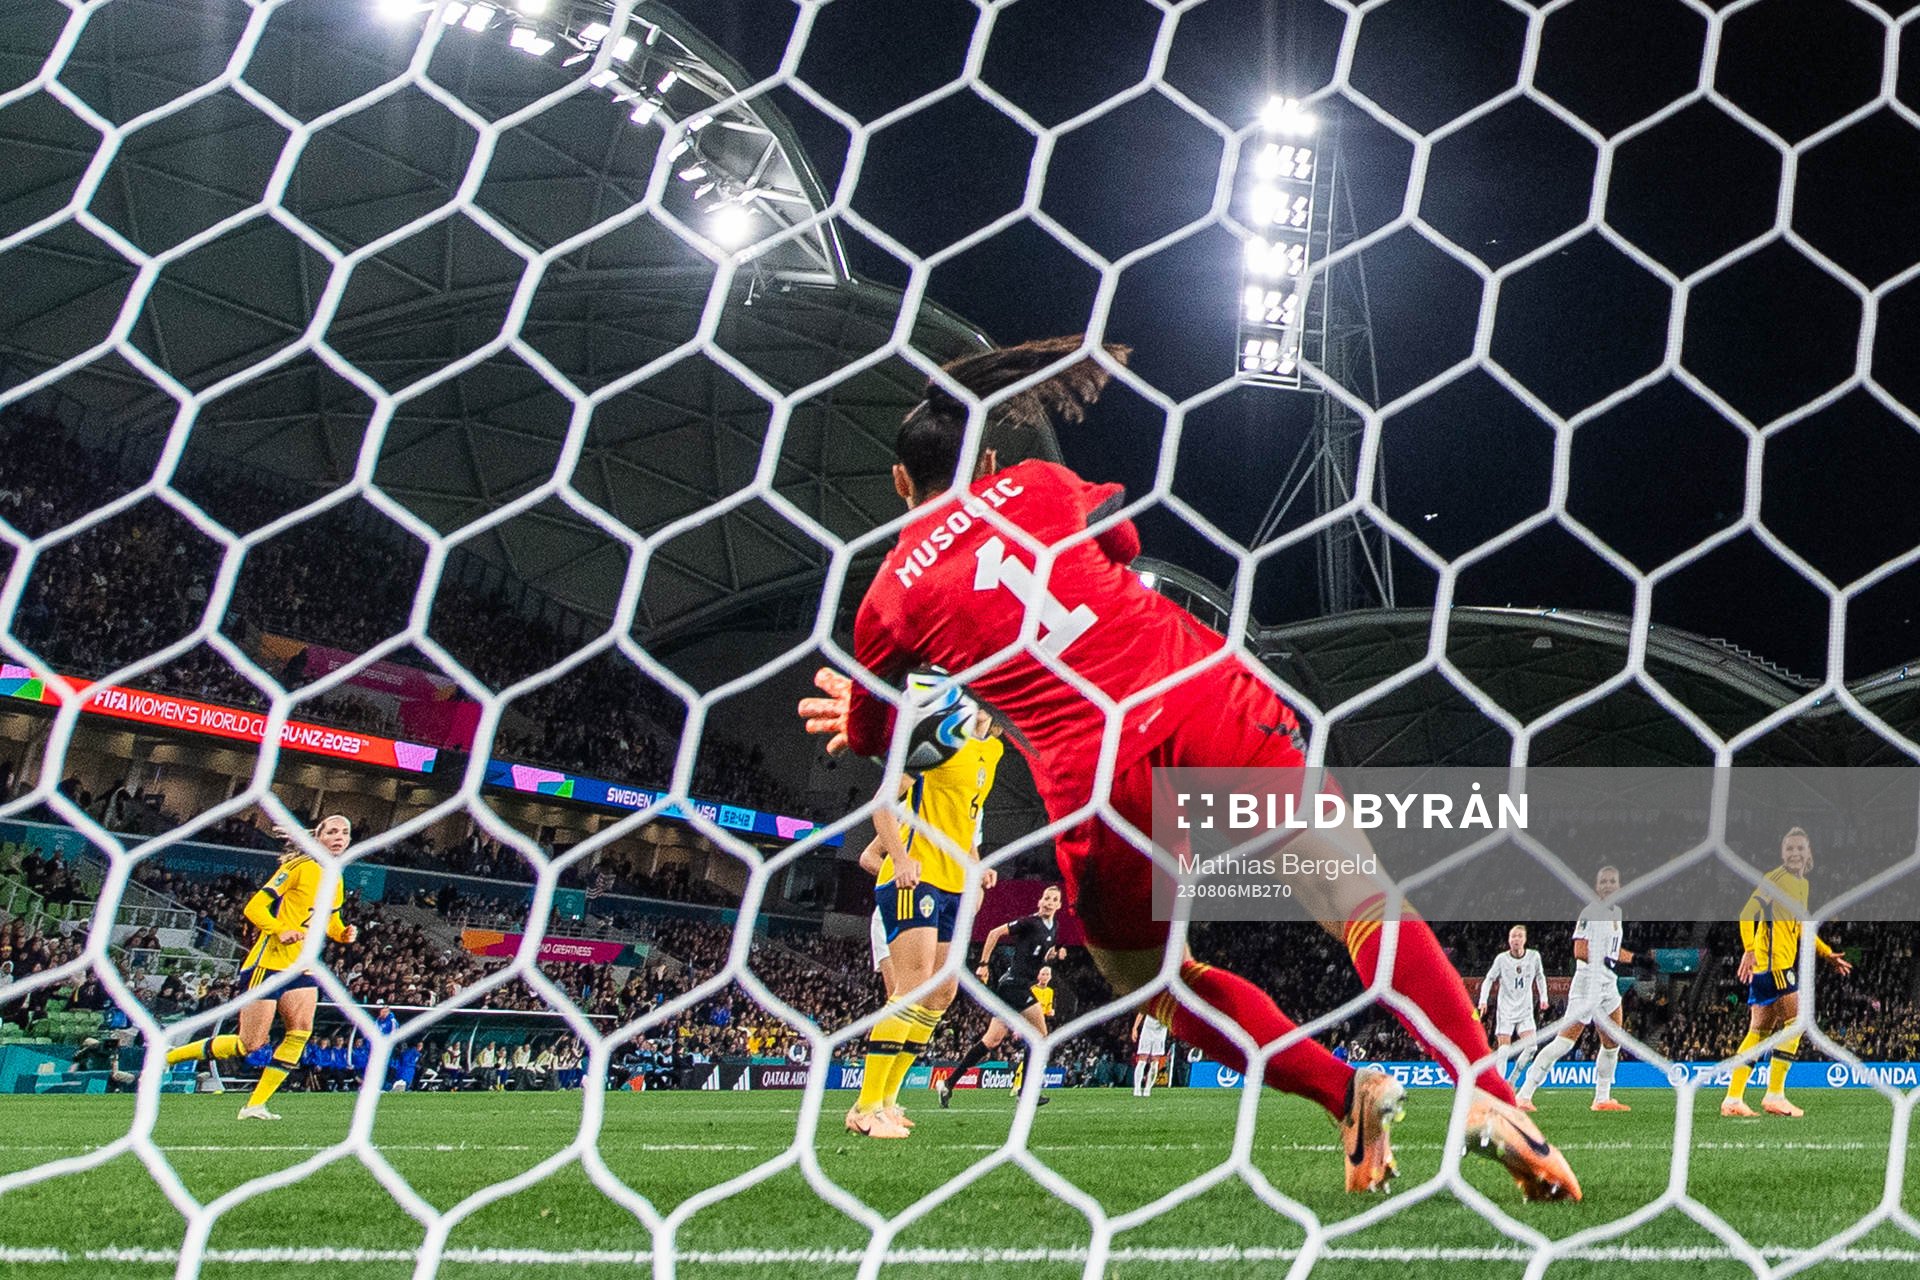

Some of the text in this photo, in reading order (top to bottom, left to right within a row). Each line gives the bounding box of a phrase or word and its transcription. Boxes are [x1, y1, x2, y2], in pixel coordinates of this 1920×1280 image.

[974, 536, 1099, 660] 1
[94, 689, 128, 711] FIFA
[129, 694, 199, 724] WOMEN'S
[200, 709, 250, 733] WORLD
[606, 787, 652, 808] SWEDEN
[697, 804, 717, 821] USA
[1514, 977, 1525, 989] 14
[762, 1071, 789, 1087] QATAR
[841, 1068, 864, 1088] VISA
[982, 1070, 1014, 1088] Globant
[1389, 1065, 1456, 1086] 万达文
[1550, 1066, 1616, 1085] WAN
[1851, 1066, 1918, 1085] WANDA
